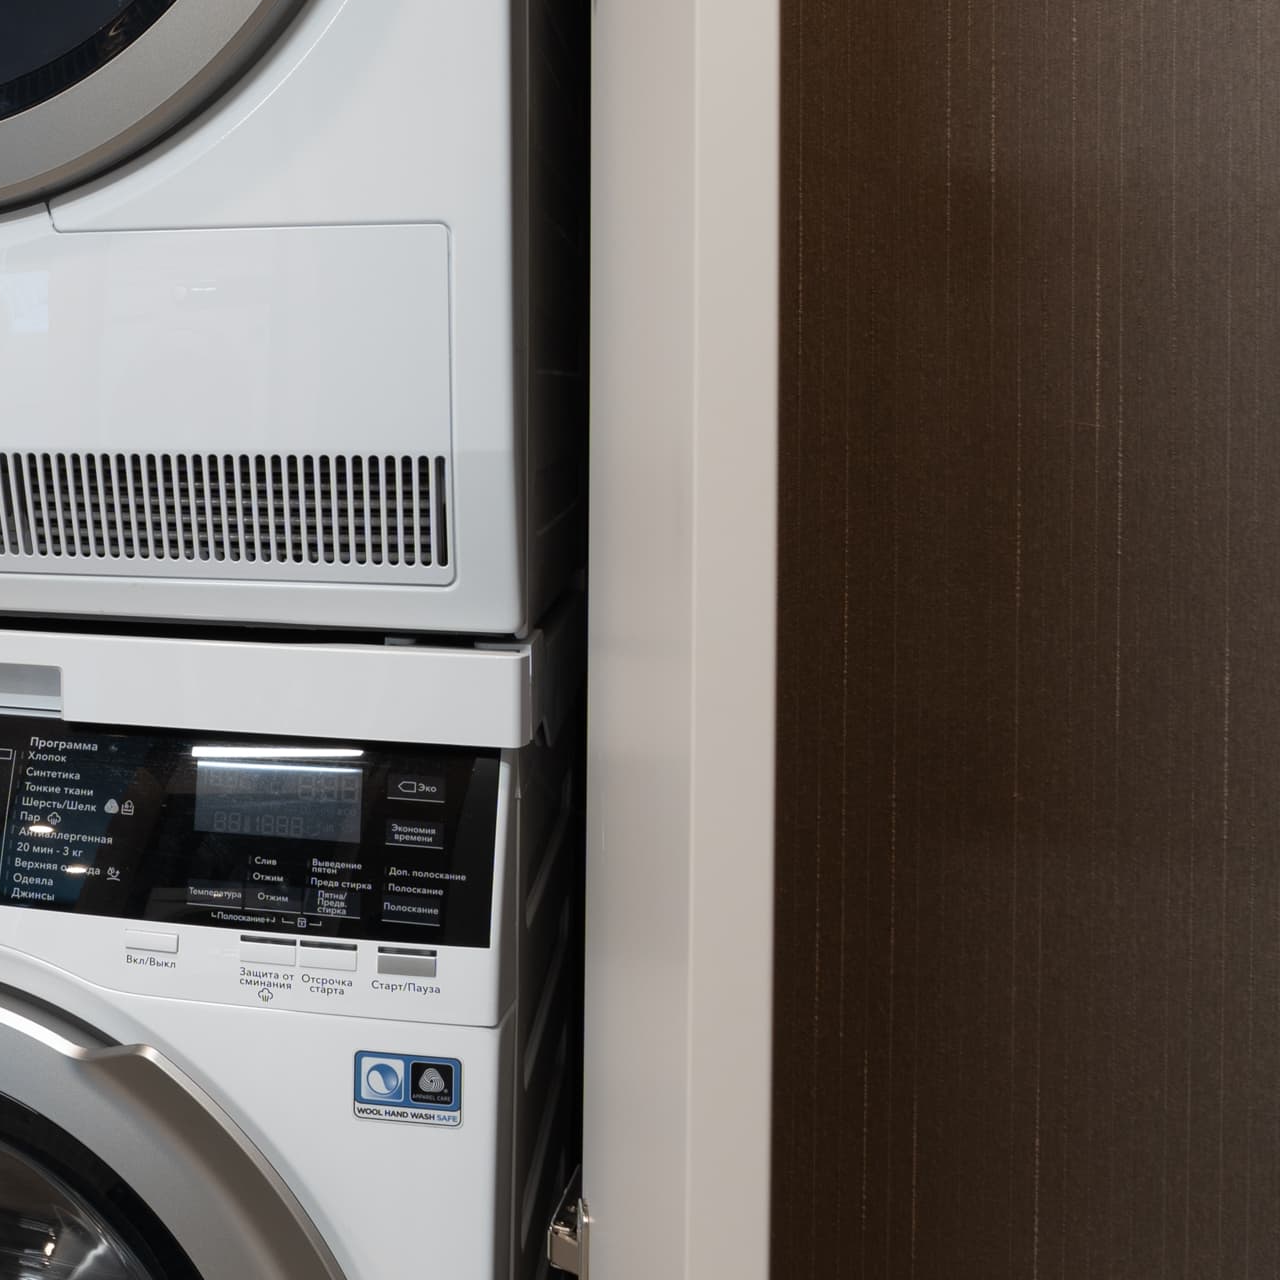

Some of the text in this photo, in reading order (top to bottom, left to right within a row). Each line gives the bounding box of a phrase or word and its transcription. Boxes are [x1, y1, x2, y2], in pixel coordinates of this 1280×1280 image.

[29, 736, 99, 753] Программа
[27, 750, 68, 763] Хлопок
[25, 766, 82, 781] Синтетика
[24, 781, 95, 797] Тонкие ткани
[418, 783, 438, 793] Эко
[21, 795, 98, 813] Шерсть/Шелк
[19, 810, 42, 823] Пар
[391, 823, 437, 836] Экономия
[394, 833, 434, 843] времени
[16, 841, 30, 853] 20
[32, 843, 54, 855] мин
[62, 846, 69, 856] 3
[72, 848, 85, 858] кг
[14, 857, 59, 871] Верхняя
[254, 855, 278, 866] Слив
[311, 857, 363, 871] Выведение
[252, 871, 284, 882] Отжим
[311, 866, 338, 875] пятен
[388, 866, 467, 882] Доп. полоскание
[12, 872, 55, 887] Одеяла
[310, 877, 373, 891] Предв стирка
[10, 887, 56, 902] Джинсы
[188, 886, 243, 900] Температура
[317, 889, 349, 900] Пятна/
[387, 882, 445, 897] Полоскание
[257, 892, 289, 903] Отжим
[317, 898, 348, 908] Предв.
[317, 906, 348, 916] стирка
[383, 901, 440, 916] Полоскание
[125, 954, 177, 969] Вкл/Выкл
[239, 967, 295, 982] Защита от
[239, 978, 292, 991] сминания
[301, 973, 354, 991] Отсрочка
[370, 979, 442, 996] Старт/Пауза
[309, 985, 345, 997] старта
[357, 1106, 459, 1123] WOOL HAND WASH SAFE
